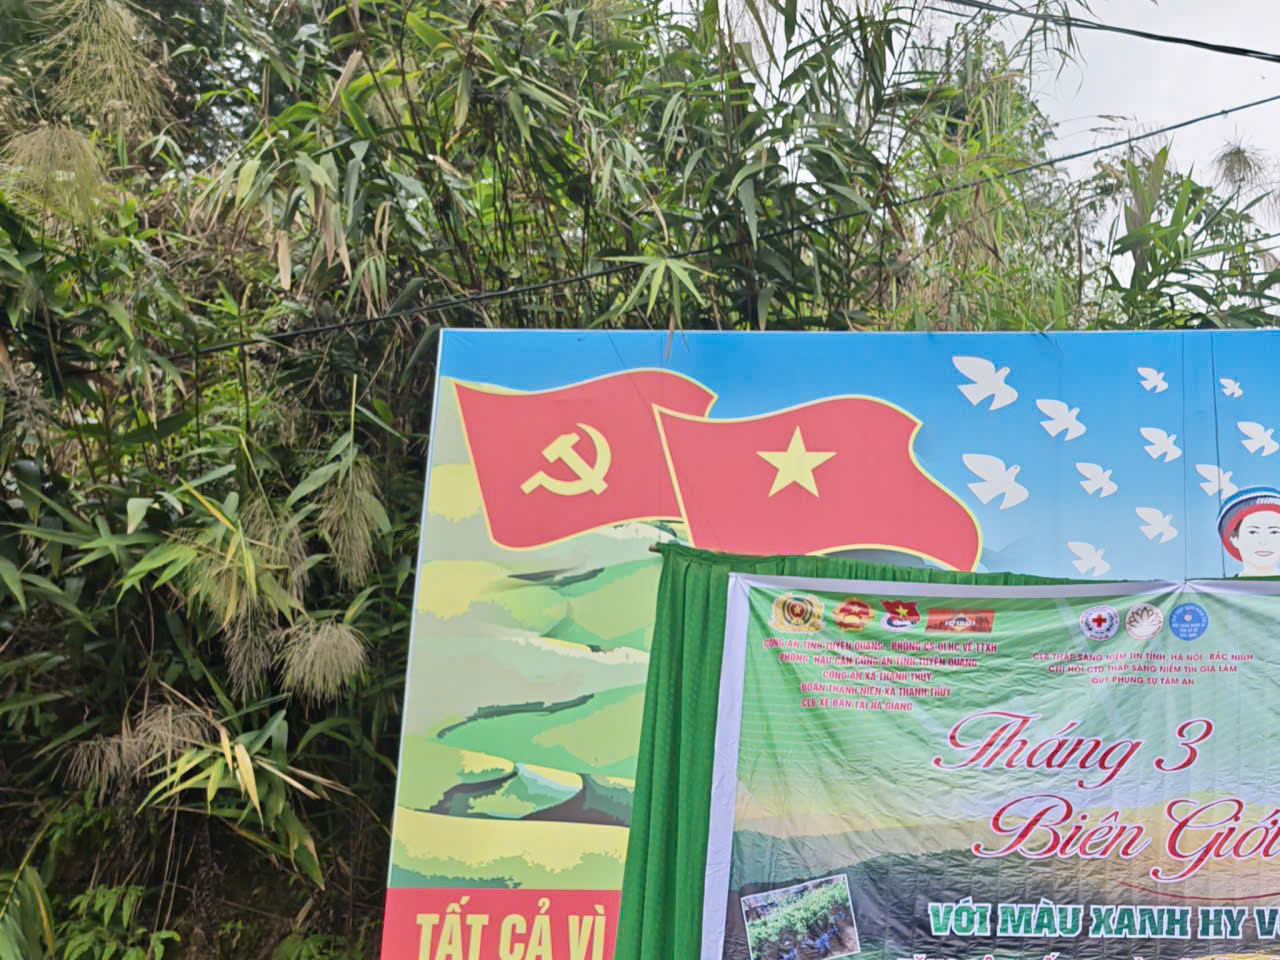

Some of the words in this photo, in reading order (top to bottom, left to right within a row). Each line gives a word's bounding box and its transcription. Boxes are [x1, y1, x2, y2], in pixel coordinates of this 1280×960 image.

[933, 710, 1145, 789] Tháng
[1154, 719, 1214, 772] 3
[972, 793, 1154, 860] Biên
[928, 896, 992, 936] VỚI
[997, 897, 1084, 938] MÀU
[1089, 904, 1192, 939] XANH
[1198, 906, 1249, 940] HY
